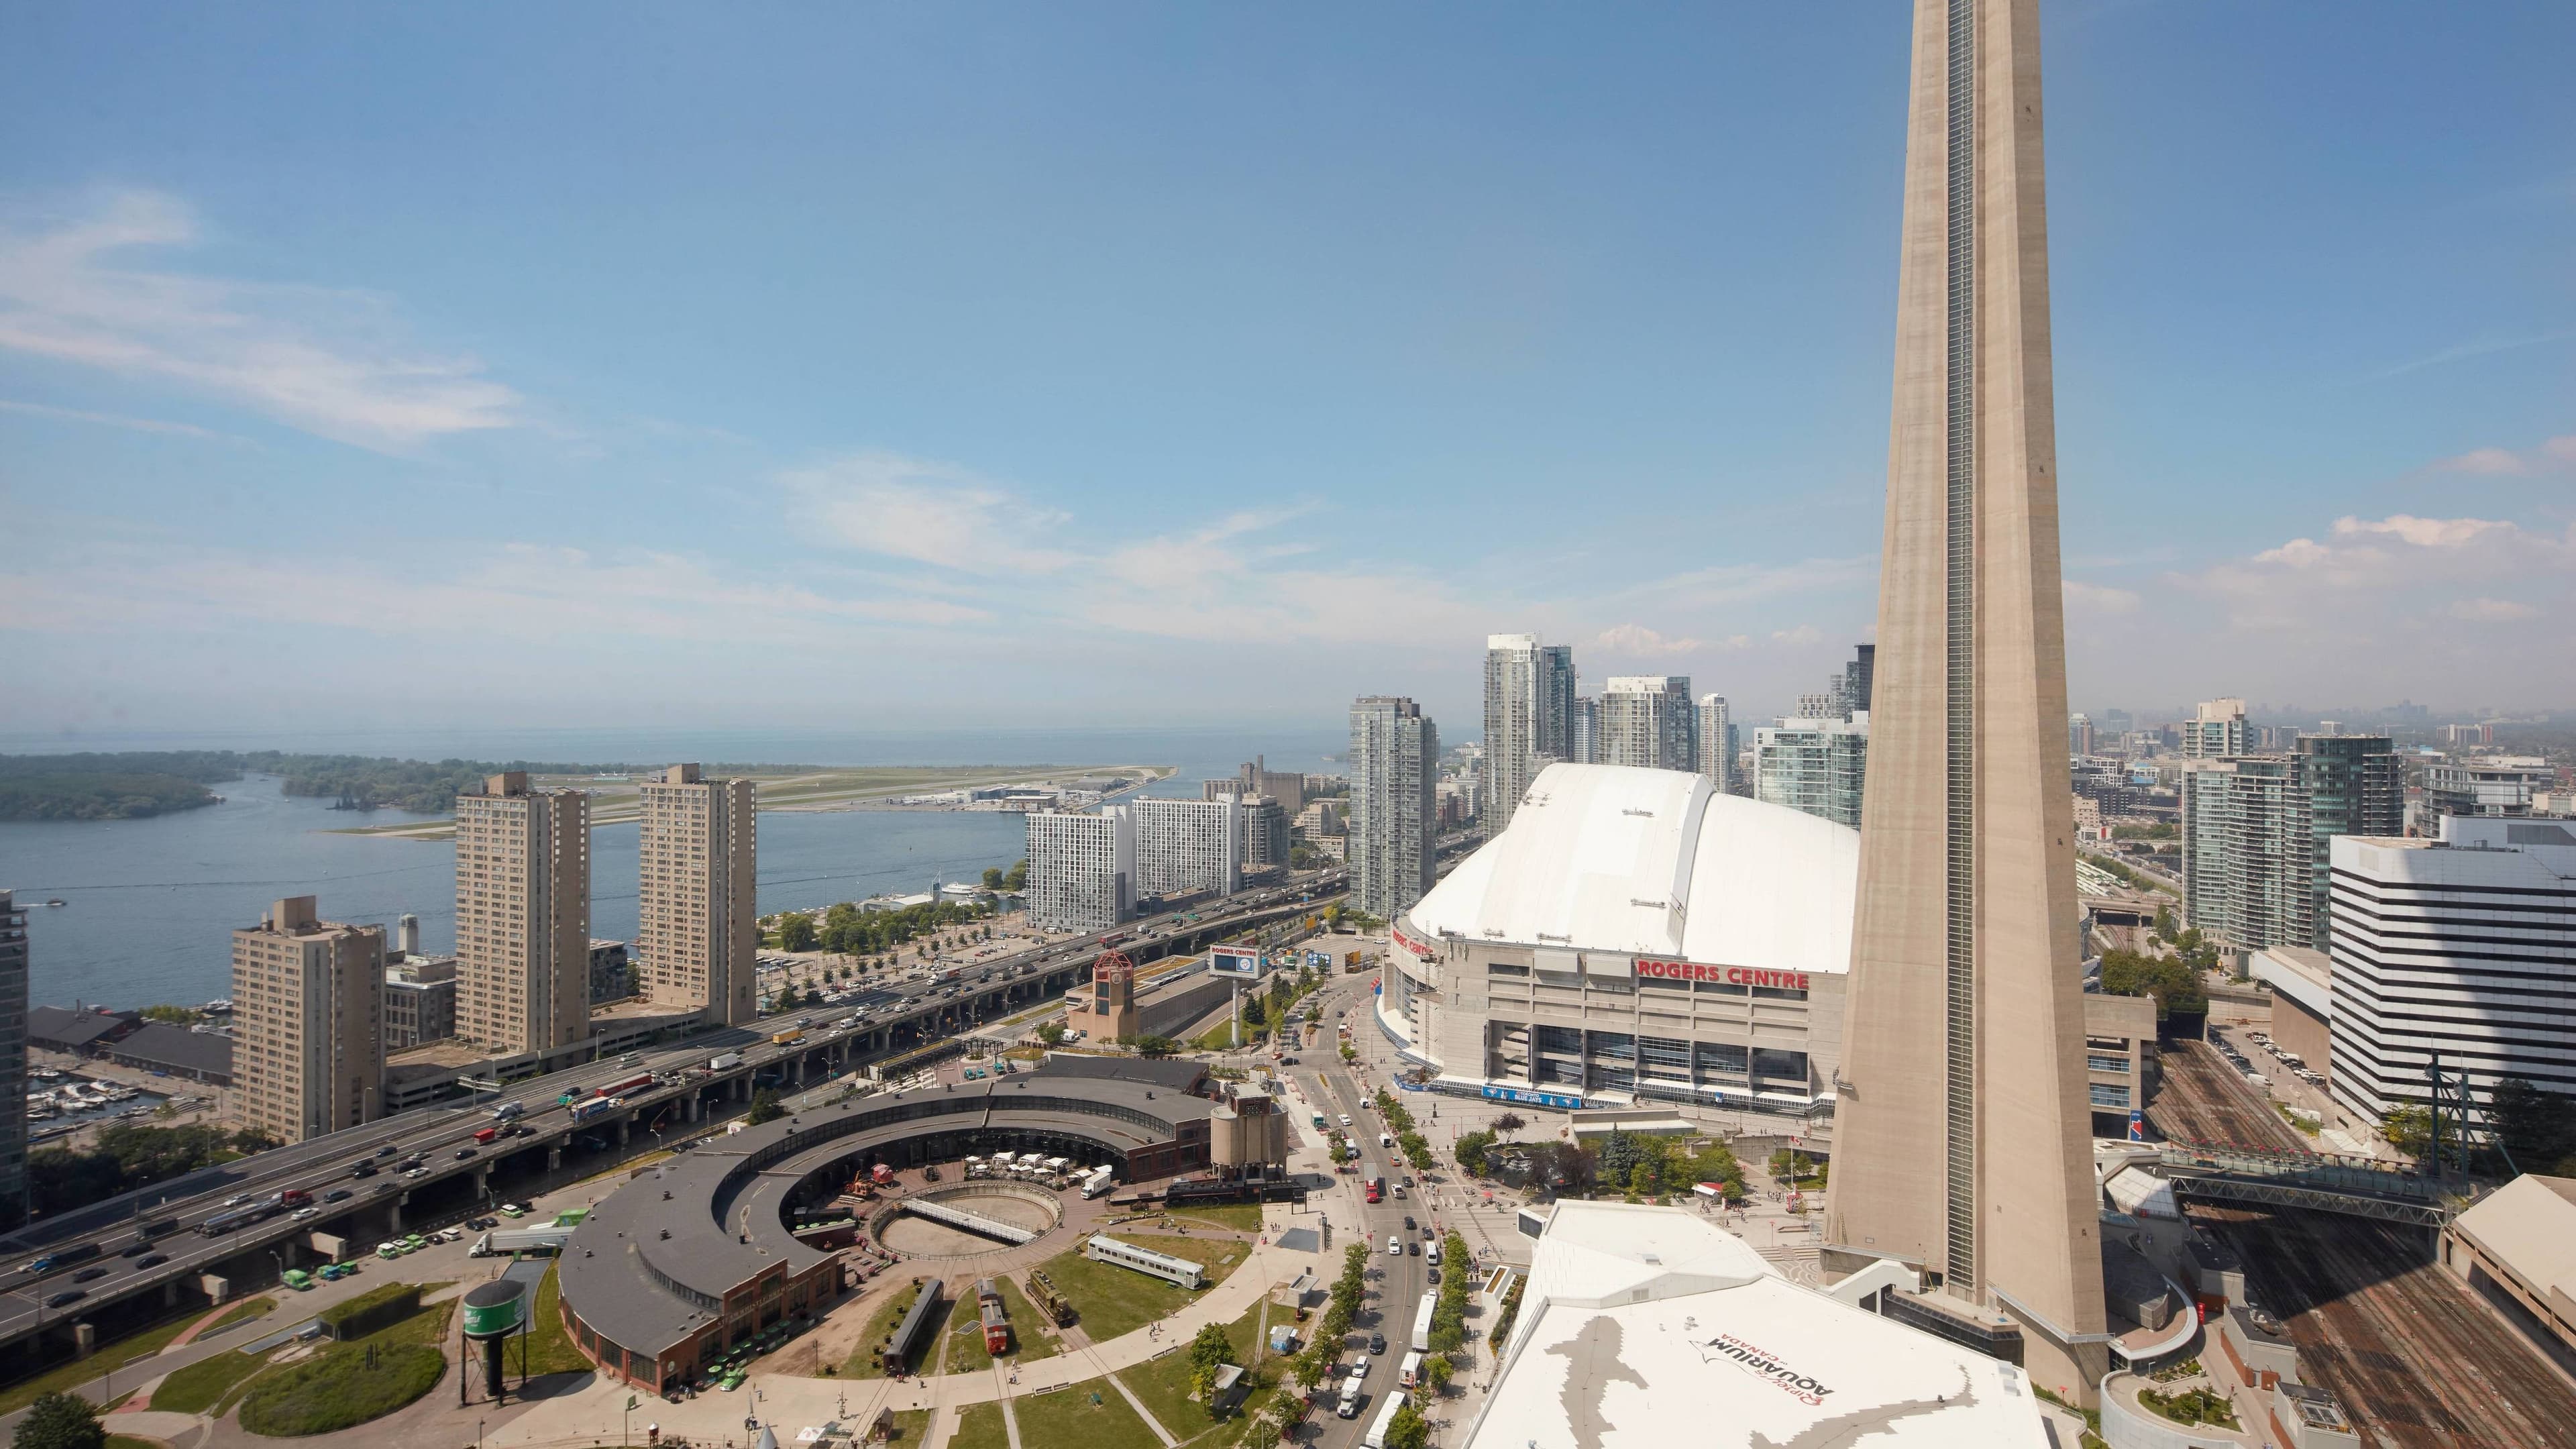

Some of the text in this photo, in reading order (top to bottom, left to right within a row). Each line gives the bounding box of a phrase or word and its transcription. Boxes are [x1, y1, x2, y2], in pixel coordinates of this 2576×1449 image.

[1638, 960, 1809, 989] ROGERS CENTRE
[1721, 1333, 1780, 1361] CANADA
[1708, 1338, 1835, 1396] AQUARIUM
